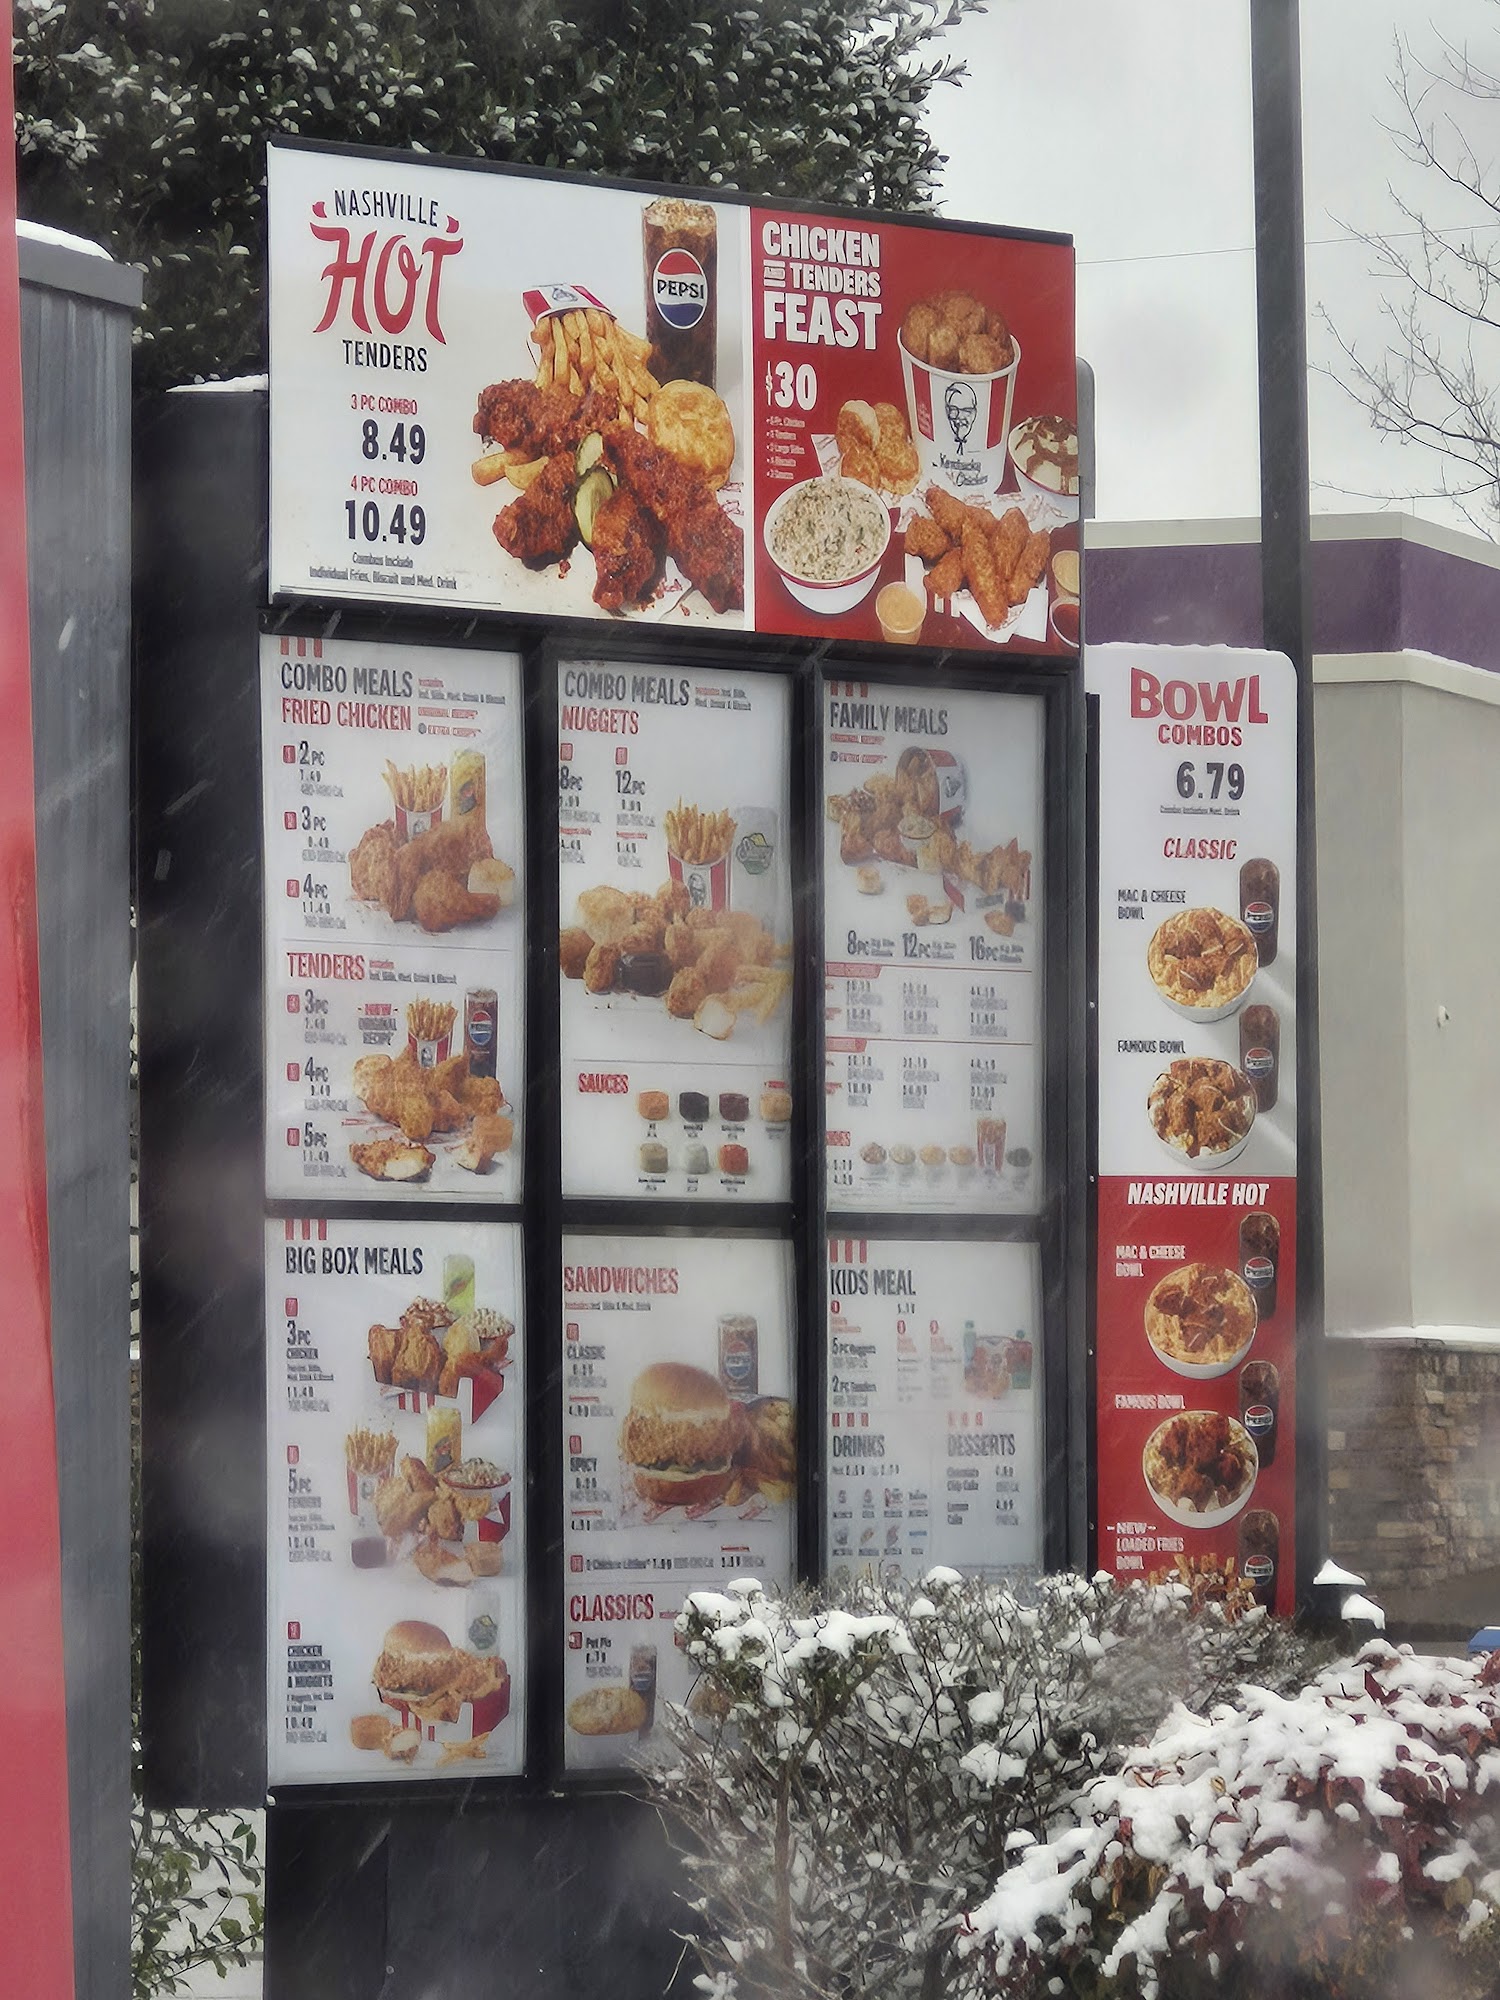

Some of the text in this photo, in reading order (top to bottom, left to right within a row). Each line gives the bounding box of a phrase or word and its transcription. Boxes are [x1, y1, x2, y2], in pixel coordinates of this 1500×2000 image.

[334, 190, 439, 227] NASHVILLE
[762, 220, 880, 268] CHICKEN
[309, 222, 464, 345] HOT
[657, 279, 704, 299] PEPSI
[790, 262, 881, 297] TENDERS
[763, 290, 882, 350] FEAST
[342, 339, 427, 372] TENDERS
[765, 360, 818, 411] $30
[351, 394, 418, 415] 3 PC COMBO
[362, 419, 426, 465] 8.49
[350, 475, 418, 496] 4 PC COMBO
[345, 500, 426, 545] 10.49
[281, 662, 347, 694] COMBO
[353, 667, 413, 698] MEALS
[565, 670, 626, 701] COMBO
[631, 675, 690, 706] MEALS
[1131, 667, 1269, 724] BOWL
[281, 696, 331, 725] FRIED
[337, 701, 412, 731] CHICKEN
[561, 706, 639, 735] NUGGETS
[830, 702, 948, 735] FAMILY MEALS
[1158, 724, 1243, 747] COMBOS
[1176, 761, 1245, 801] 6.79
[1163, 837, 1238, 860] CLASSIC
[1117, 889, 1138, 902] MAC
[1117, 906, 1145, 920] BOWL
[287, 952, 365, 981] TENDERS
[1117, 1039, 1186, 1054] FAMOUS BOWL
[578, 1072, 629, 1094] SAUCES
[1127, 1182, 1270, 1206] NASHVILLE HOT
[285, 1246, 423, 1275] BIG BOX MEALS
[564, 1266, 679, 1294] SANDWICHES
[830, 1269, 916, 1296] KIDS MEAL
[832, 1434, 1016, 1458] DRINKS DESSERTS
[570, 1593, 654, 1622] CLASSICS
